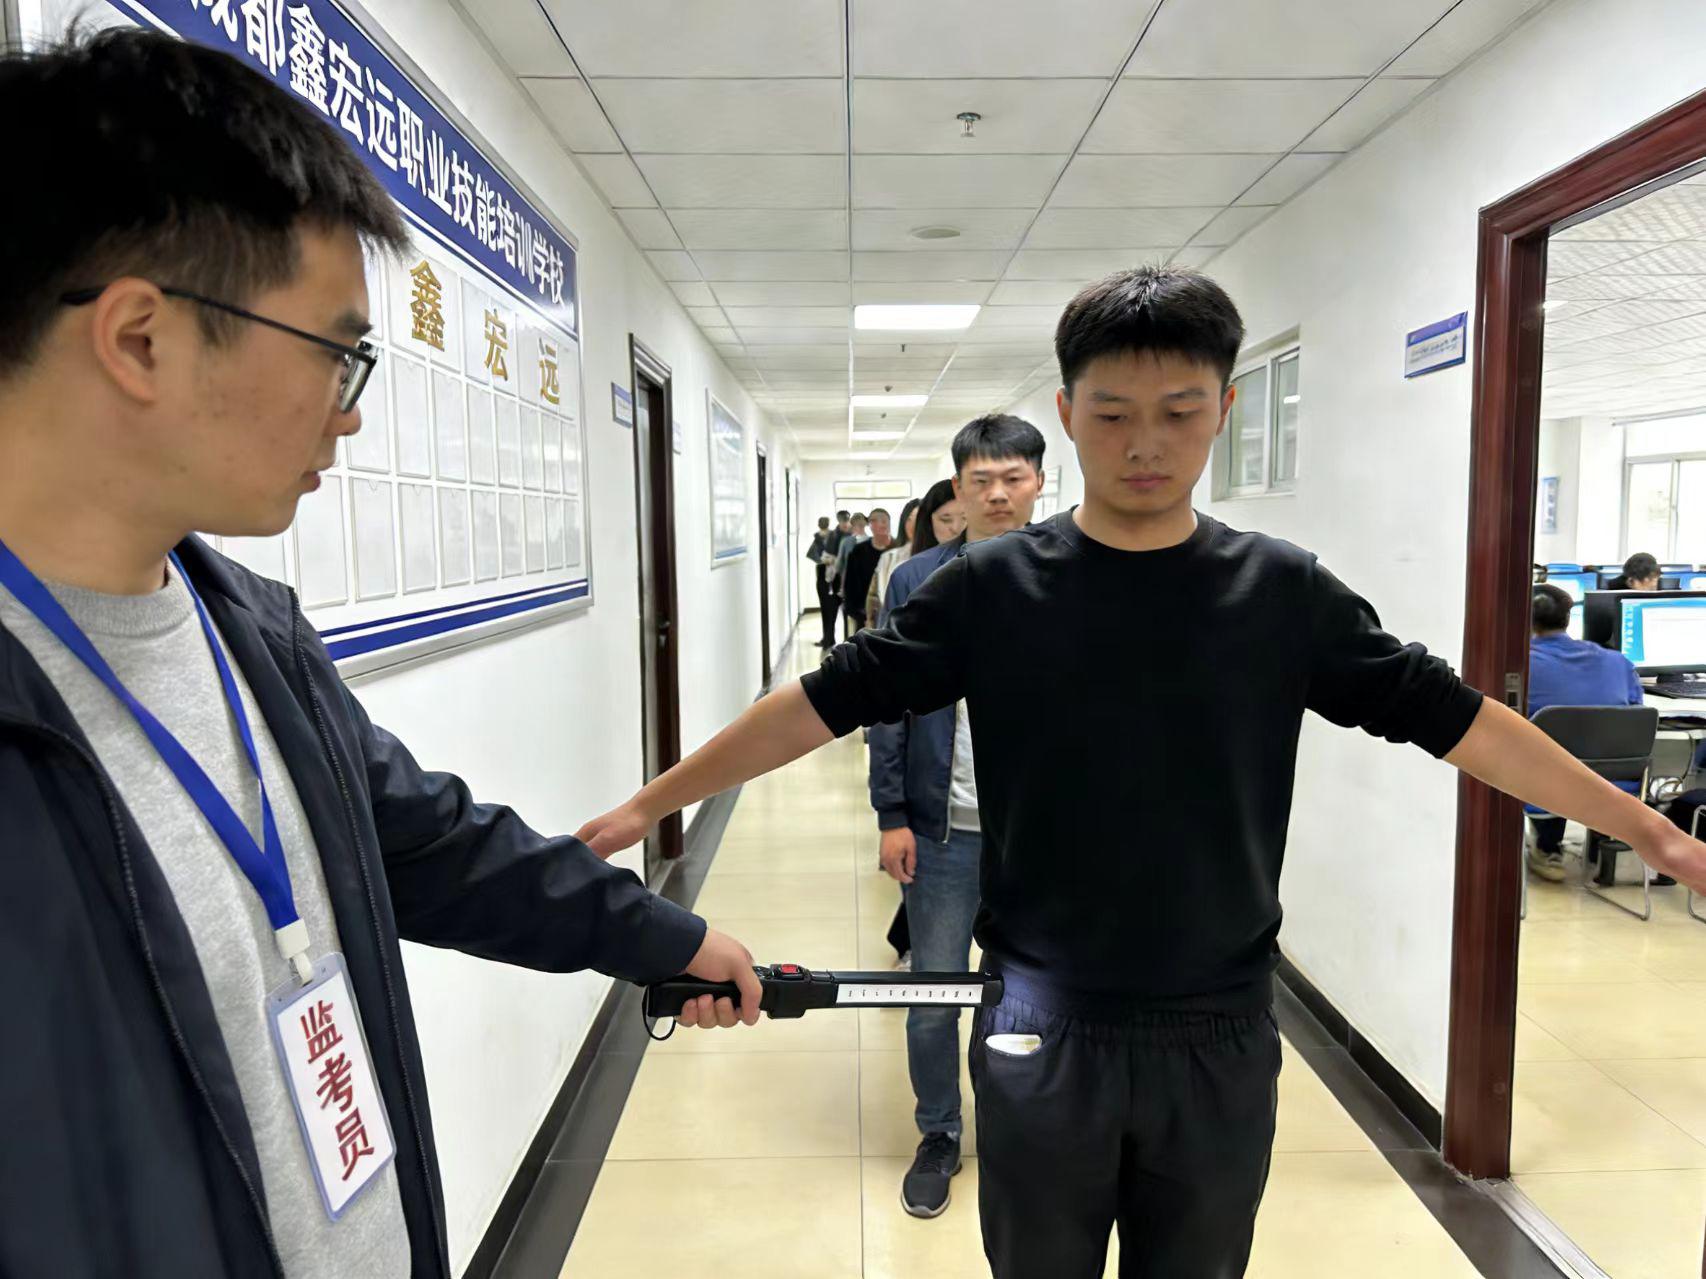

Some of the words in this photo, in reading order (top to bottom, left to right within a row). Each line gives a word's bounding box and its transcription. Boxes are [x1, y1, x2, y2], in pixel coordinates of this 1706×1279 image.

[410, 260, 560, 404] 鑫宏远
[300, 1000, 374, 1181] 监考员
